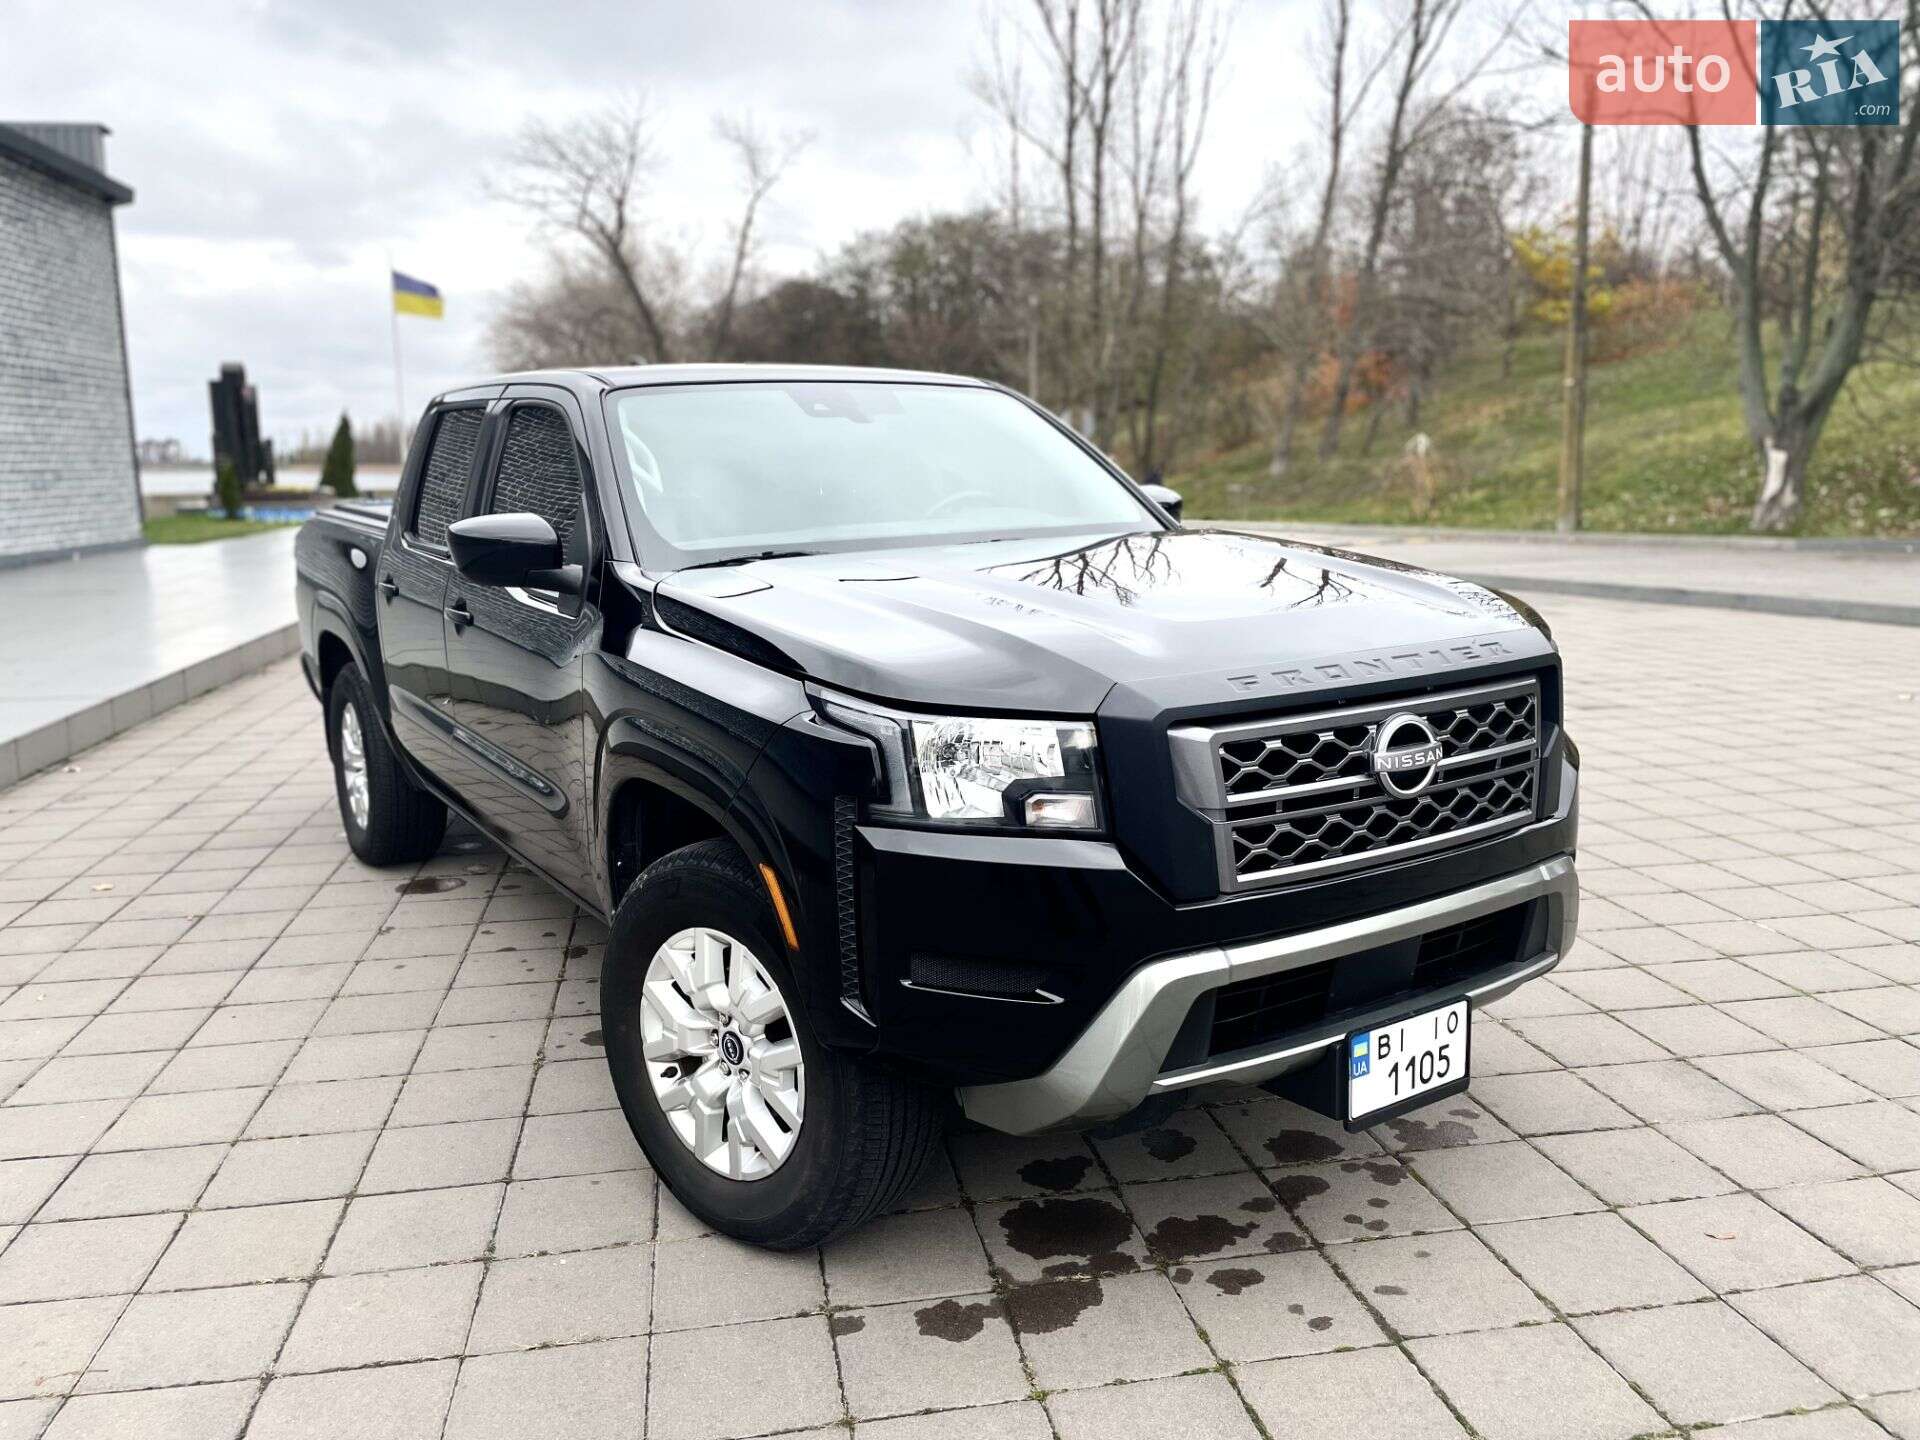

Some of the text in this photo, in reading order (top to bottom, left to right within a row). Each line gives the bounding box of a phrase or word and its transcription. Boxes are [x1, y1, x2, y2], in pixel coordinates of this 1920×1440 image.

[1226, 641, 1513, 692] FRONTIER
[1377, 748, 1443, 770] NISSAN
[1378, 1028, 1404, 1060] BI
[1353, 1060, 1368, 1075] UA
[1388, 1044, 1450, 1096] 1105
